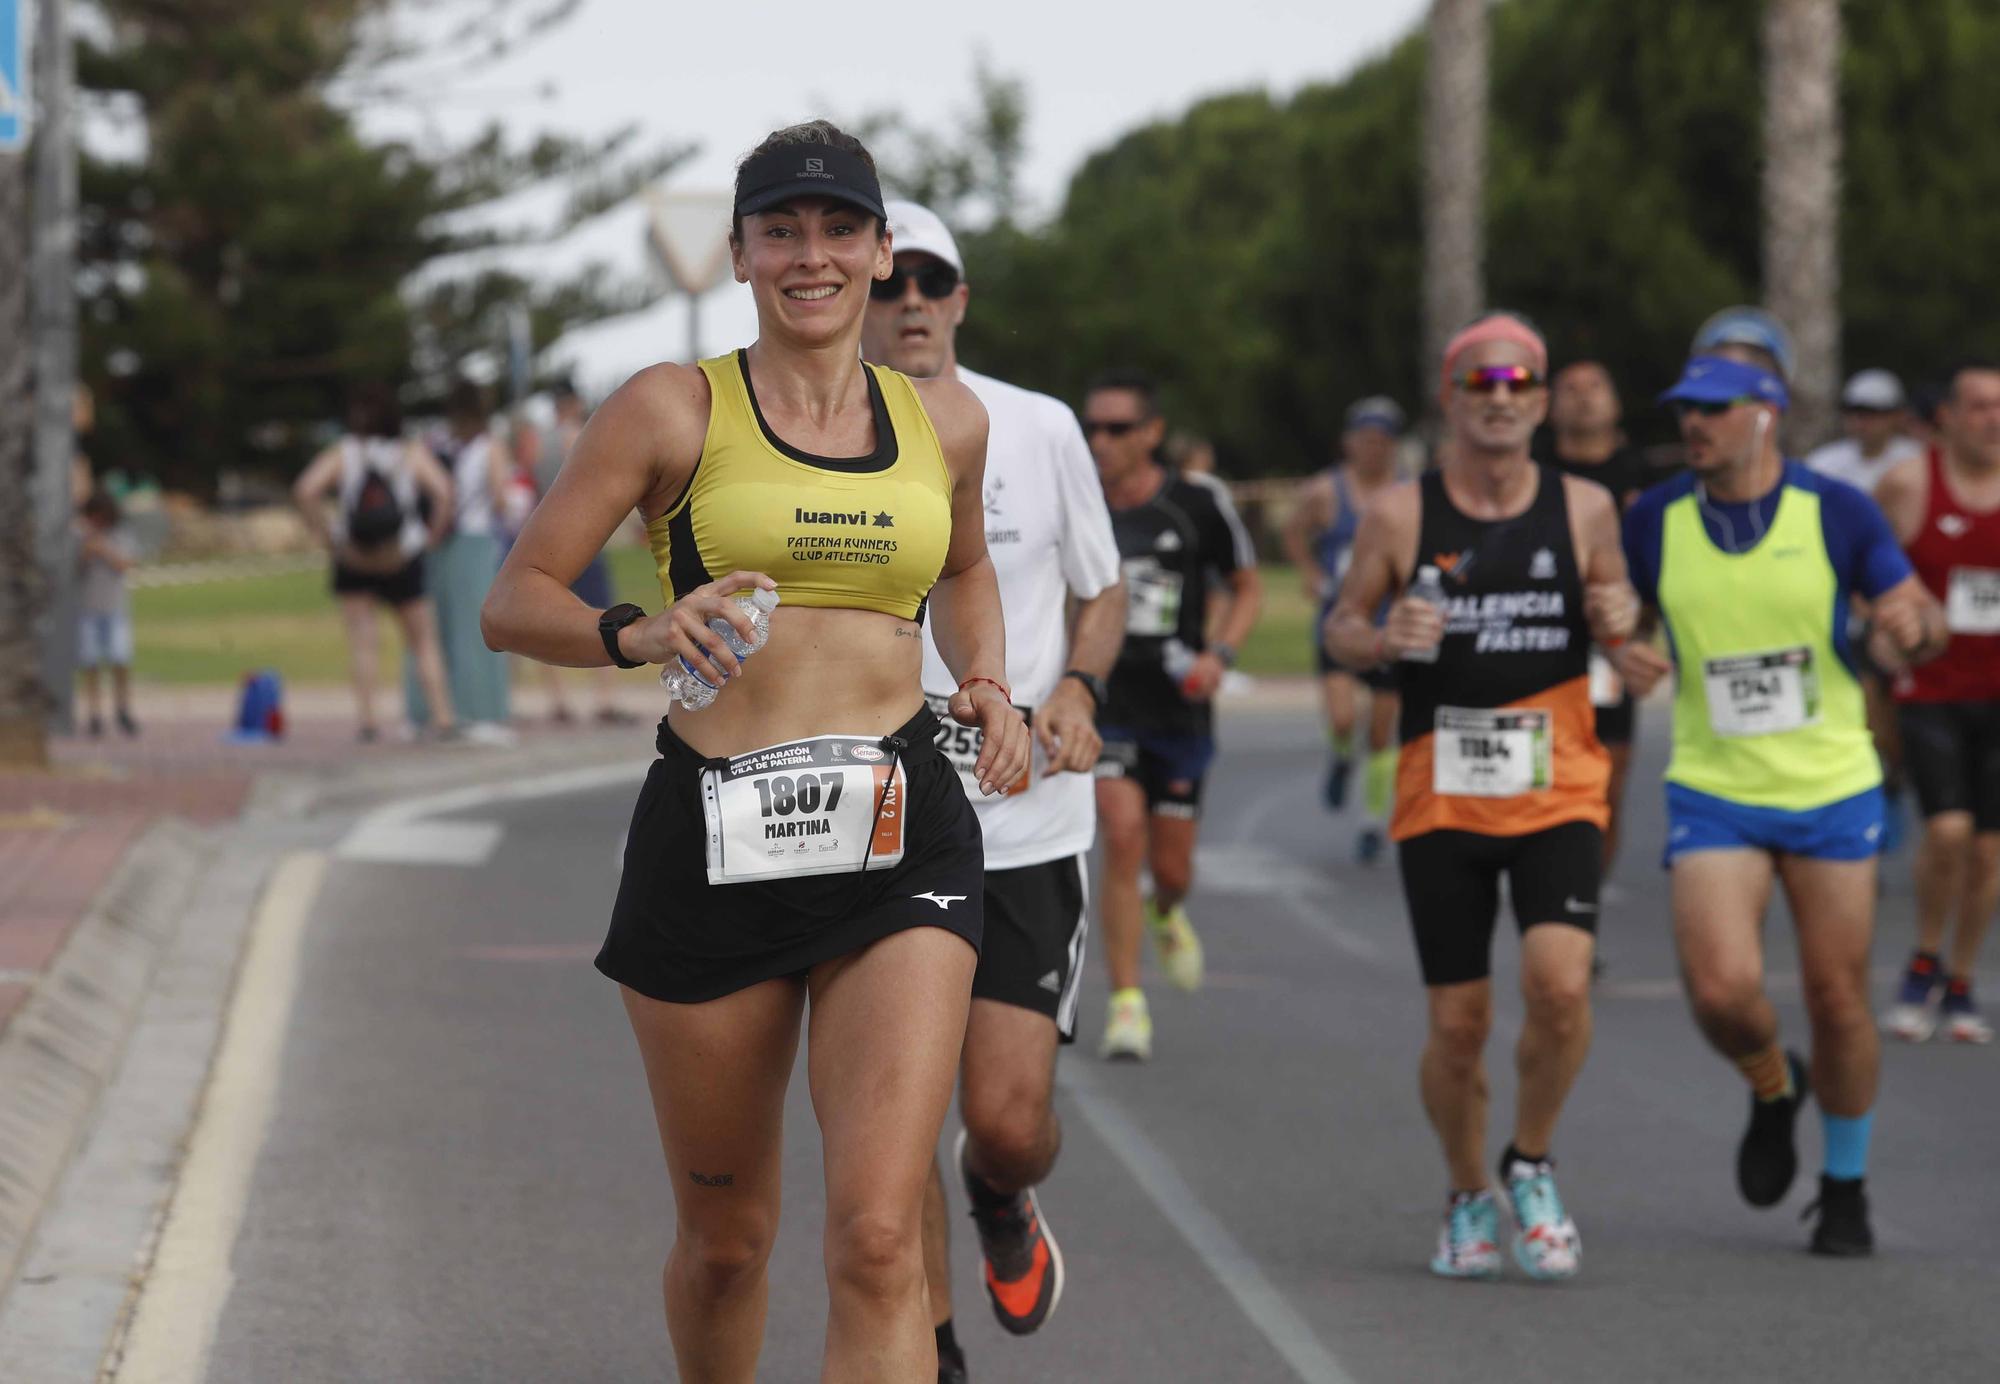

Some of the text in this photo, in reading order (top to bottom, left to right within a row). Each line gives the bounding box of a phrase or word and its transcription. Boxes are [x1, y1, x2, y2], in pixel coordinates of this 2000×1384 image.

[795, 508, 867, 525] luanvi
[787, 537, 898, 551] PATERNA RUNNERS
[792, 551, 890, 564] CLUB ATLETISMO
[730, 746, 810, 771] MEDIA MARATÓN
[731, 754, 813, 776] VILA DE PATERNA
[753, 772, 844, 817] 1807
[881, 811, 895, 819] 2
[765, 818, 831, 839] MARTINA
